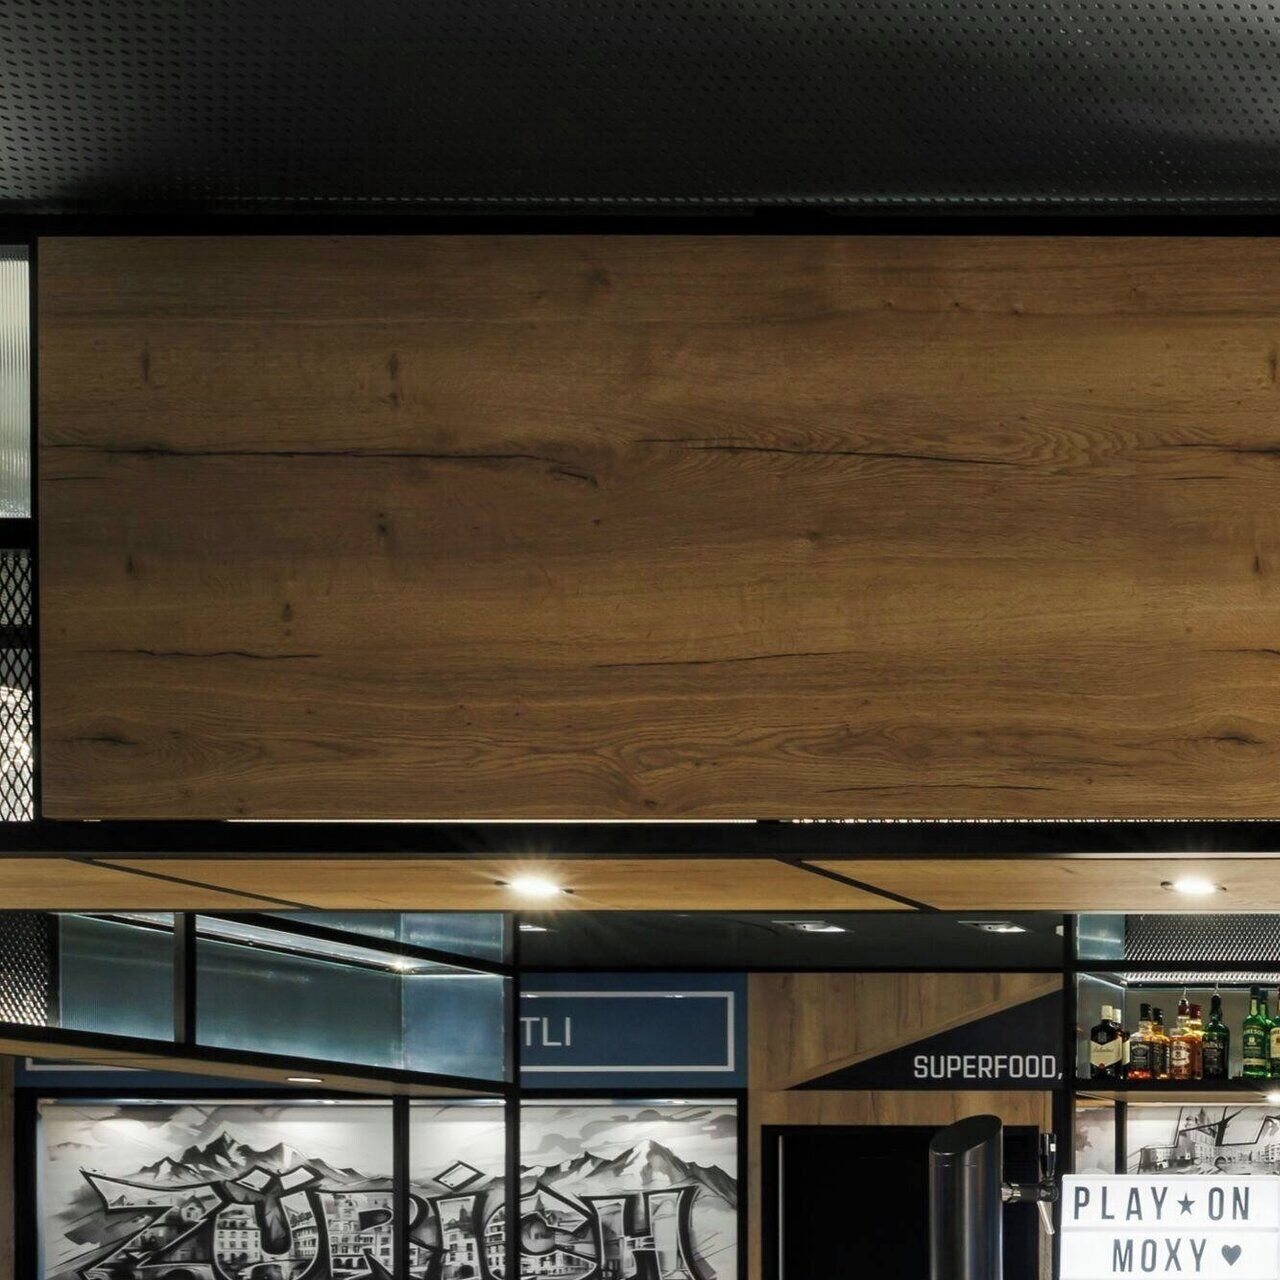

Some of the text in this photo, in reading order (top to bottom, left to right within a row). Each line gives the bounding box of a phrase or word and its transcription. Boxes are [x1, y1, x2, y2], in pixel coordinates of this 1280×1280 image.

[913, 1055, 1063, 1080] SUPERFOOD,
[1073, 1186, 1250, 1221] PLAY ON
[1112, 1238, 1207, 1273] MOXY
